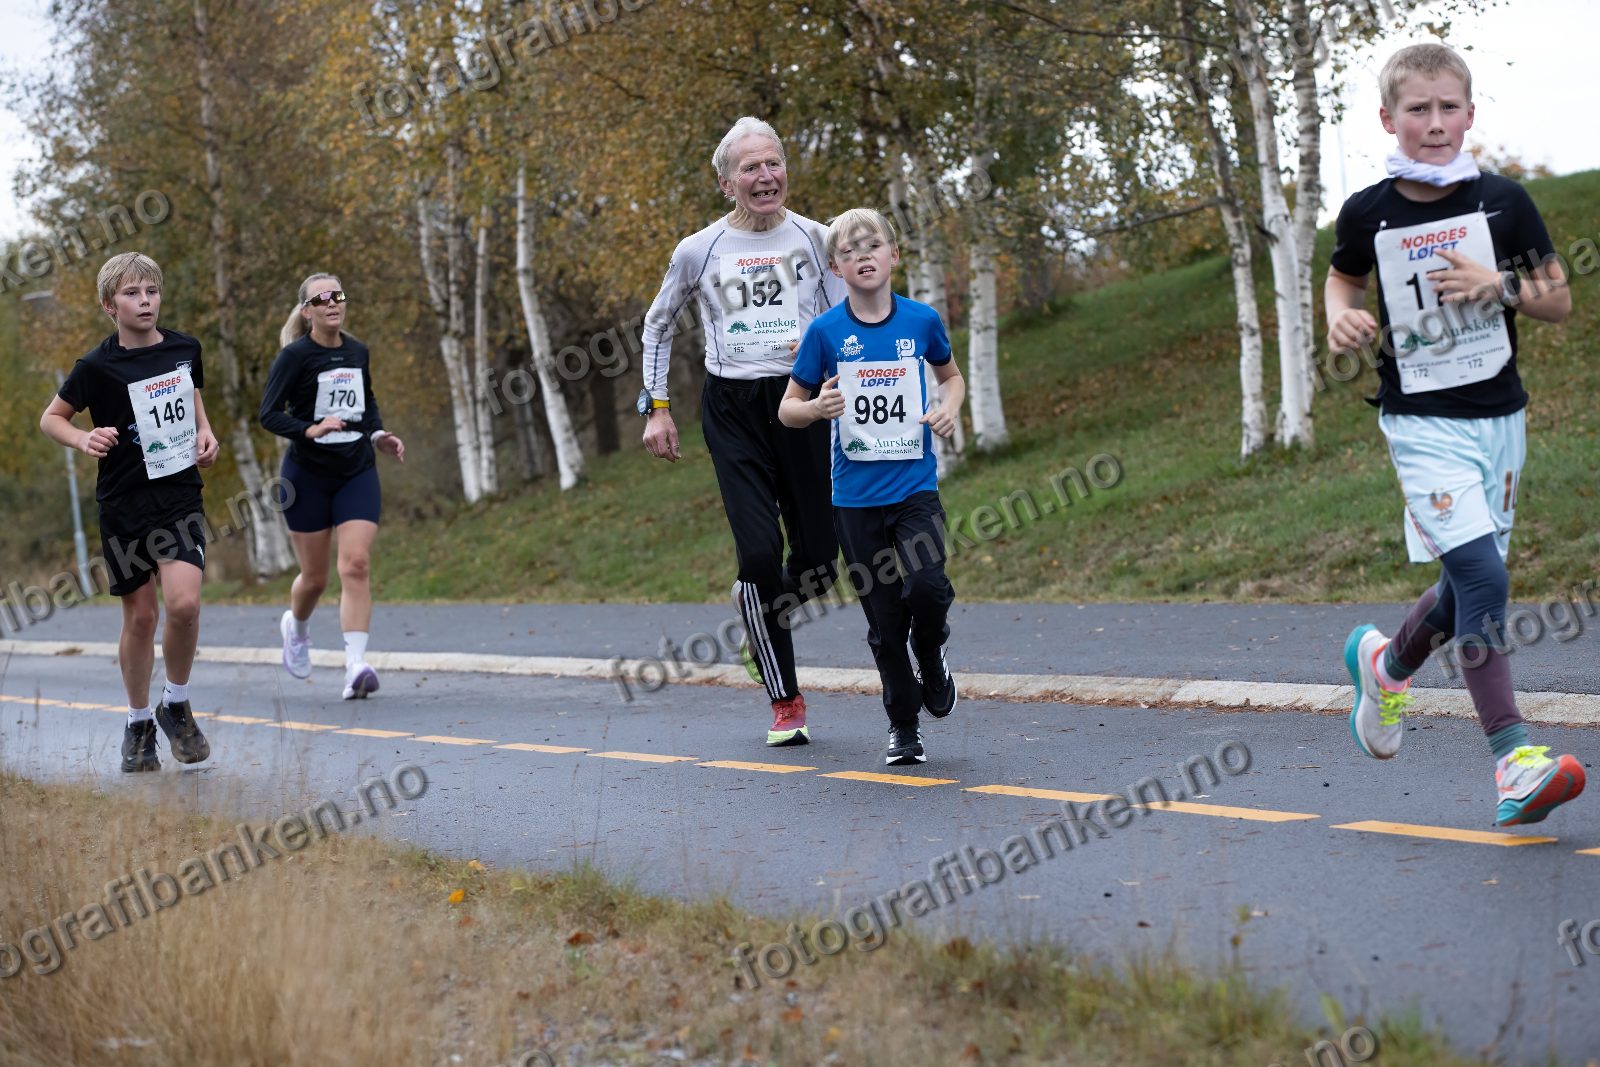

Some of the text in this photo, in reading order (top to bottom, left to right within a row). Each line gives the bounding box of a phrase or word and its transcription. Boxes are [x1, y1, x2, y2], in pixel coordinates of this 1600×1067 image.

[1401, 226, 1468, 250] NORGES
[736, 257, 782, 267] NORGES
[741, 265, 775, 275] LØPET
[737, 280, 783, 308] 152
[754, 317, 797, 329] Aurskog
[1468, 357, 1485, 369] 172
[856, 368, 906, 378] NORGES
[1412, 368, 1430, 379] 172
[144, 376, 181, 392] NORGES
[860, 378, 899, 387] LØPET
[149, 385, 177, 399] LØPET
[329, 390, 357, 408] 170
[149, 398, 185, 428] 146
[854, 395, 907, 425] 984
[874, 437, 920, 449] Aurskog
